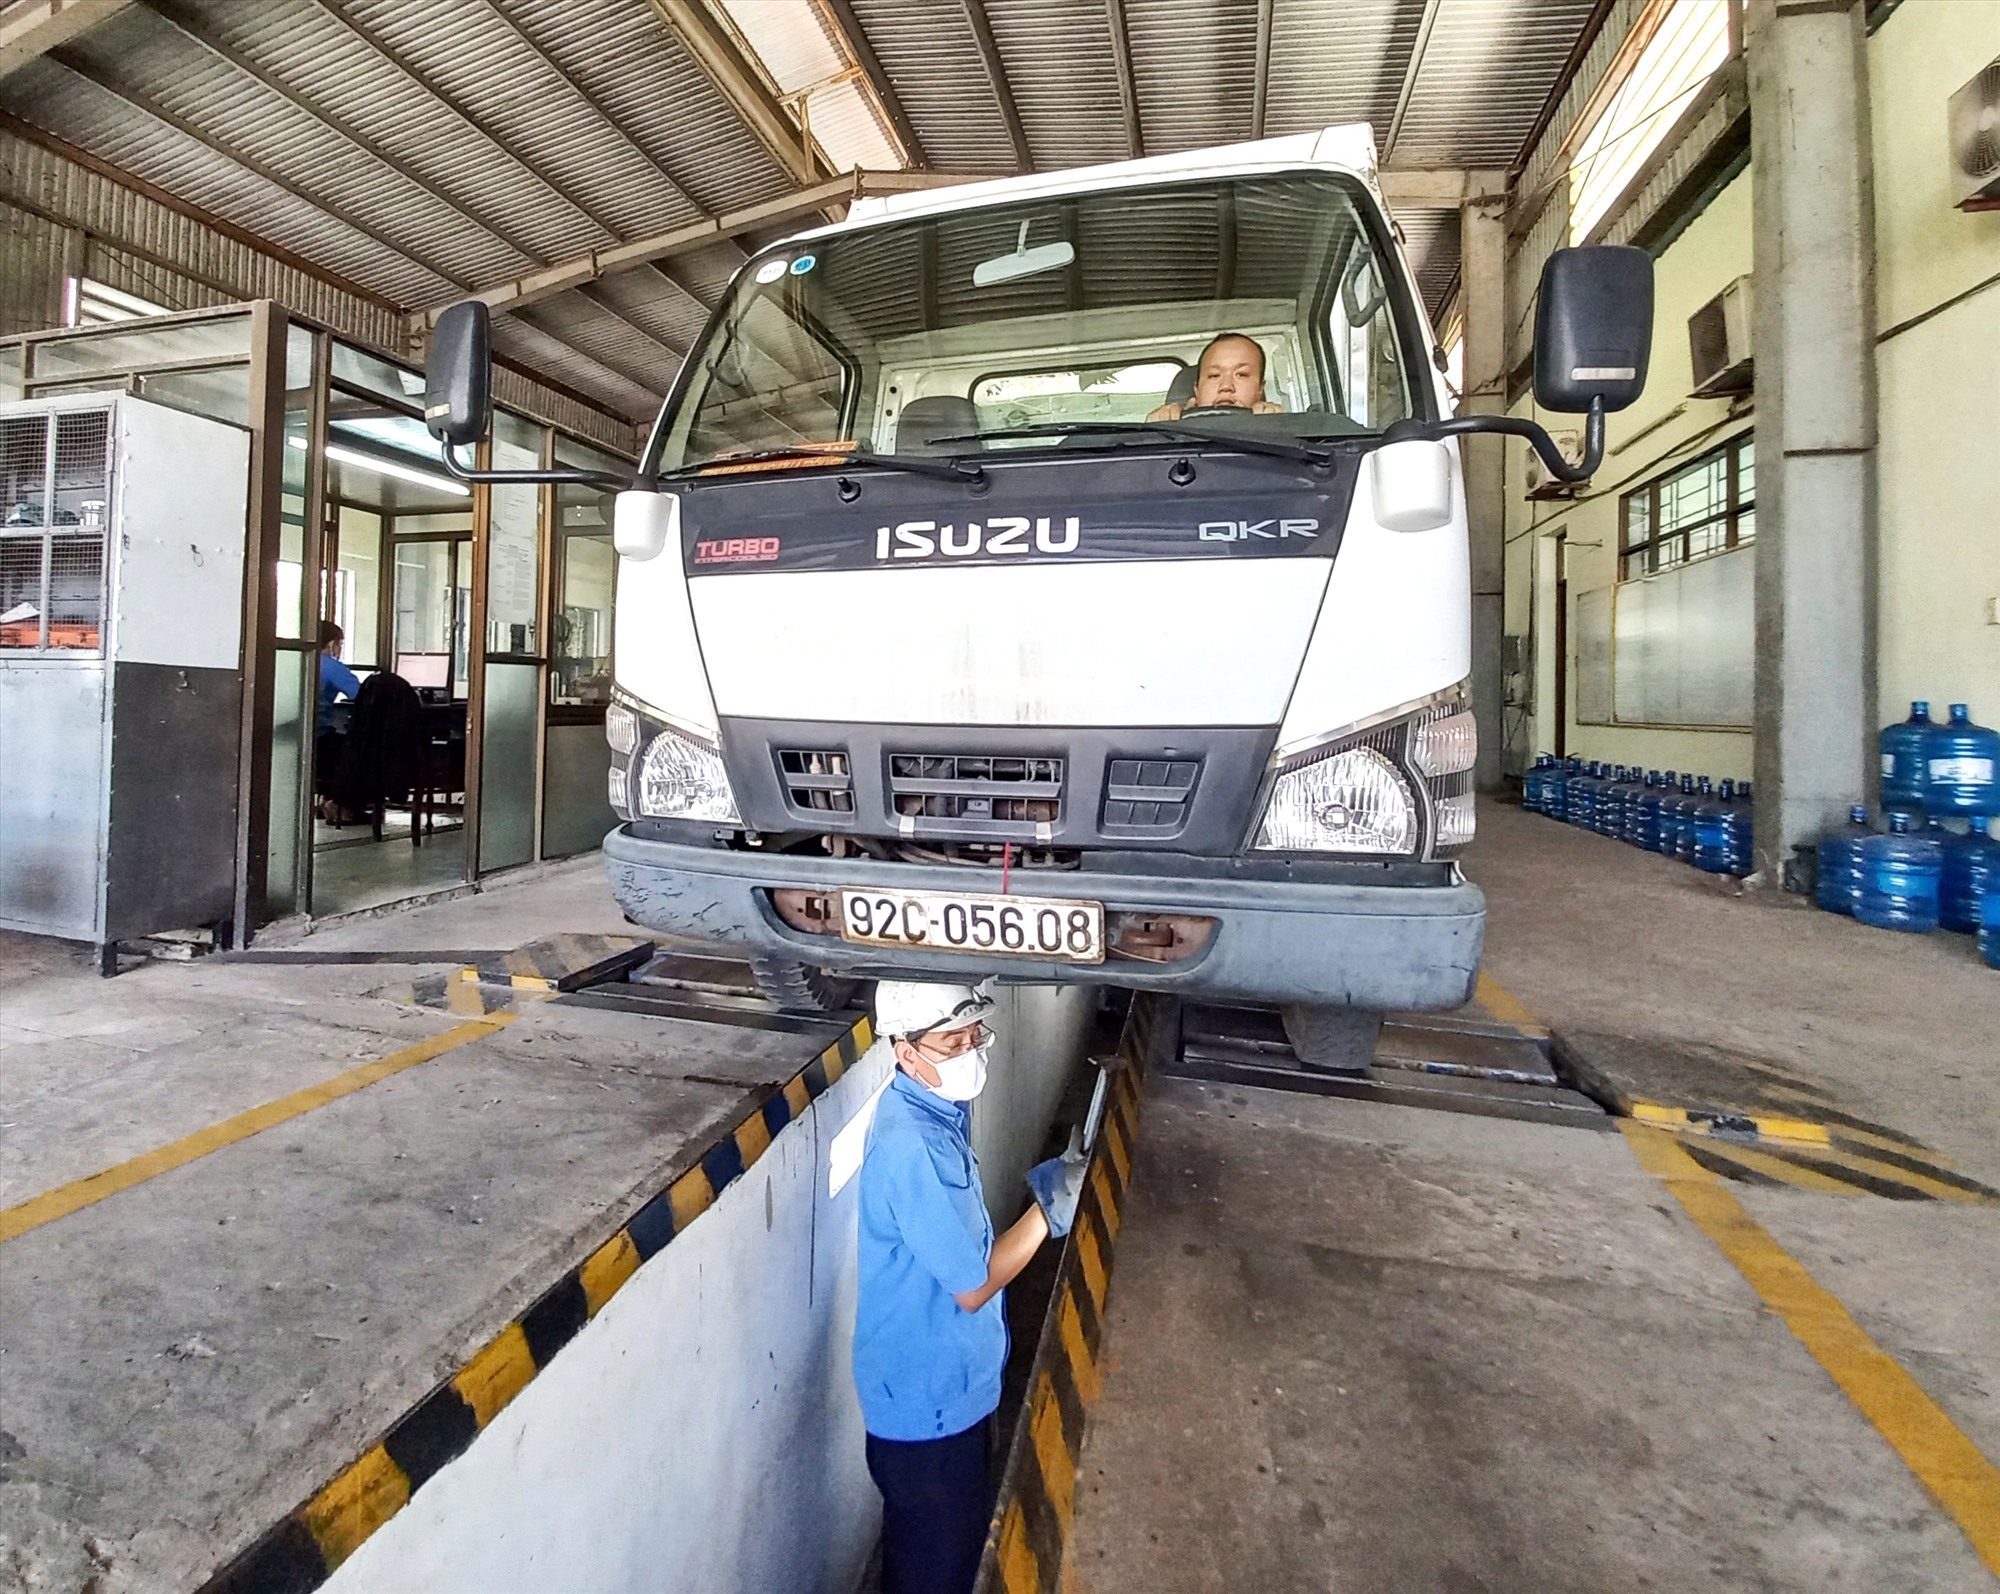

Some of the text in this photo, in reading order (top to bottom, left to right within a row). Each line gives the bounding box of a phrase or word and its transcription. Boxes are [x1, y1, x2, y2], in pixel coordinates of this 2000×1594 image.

[876, 516, 1080, 559] ISUZU
[1199, 518, 1319, 541] QKR
[696, 537, 780, 557] TURBO
[850, 896, 1092, 953] 92C-056.08
